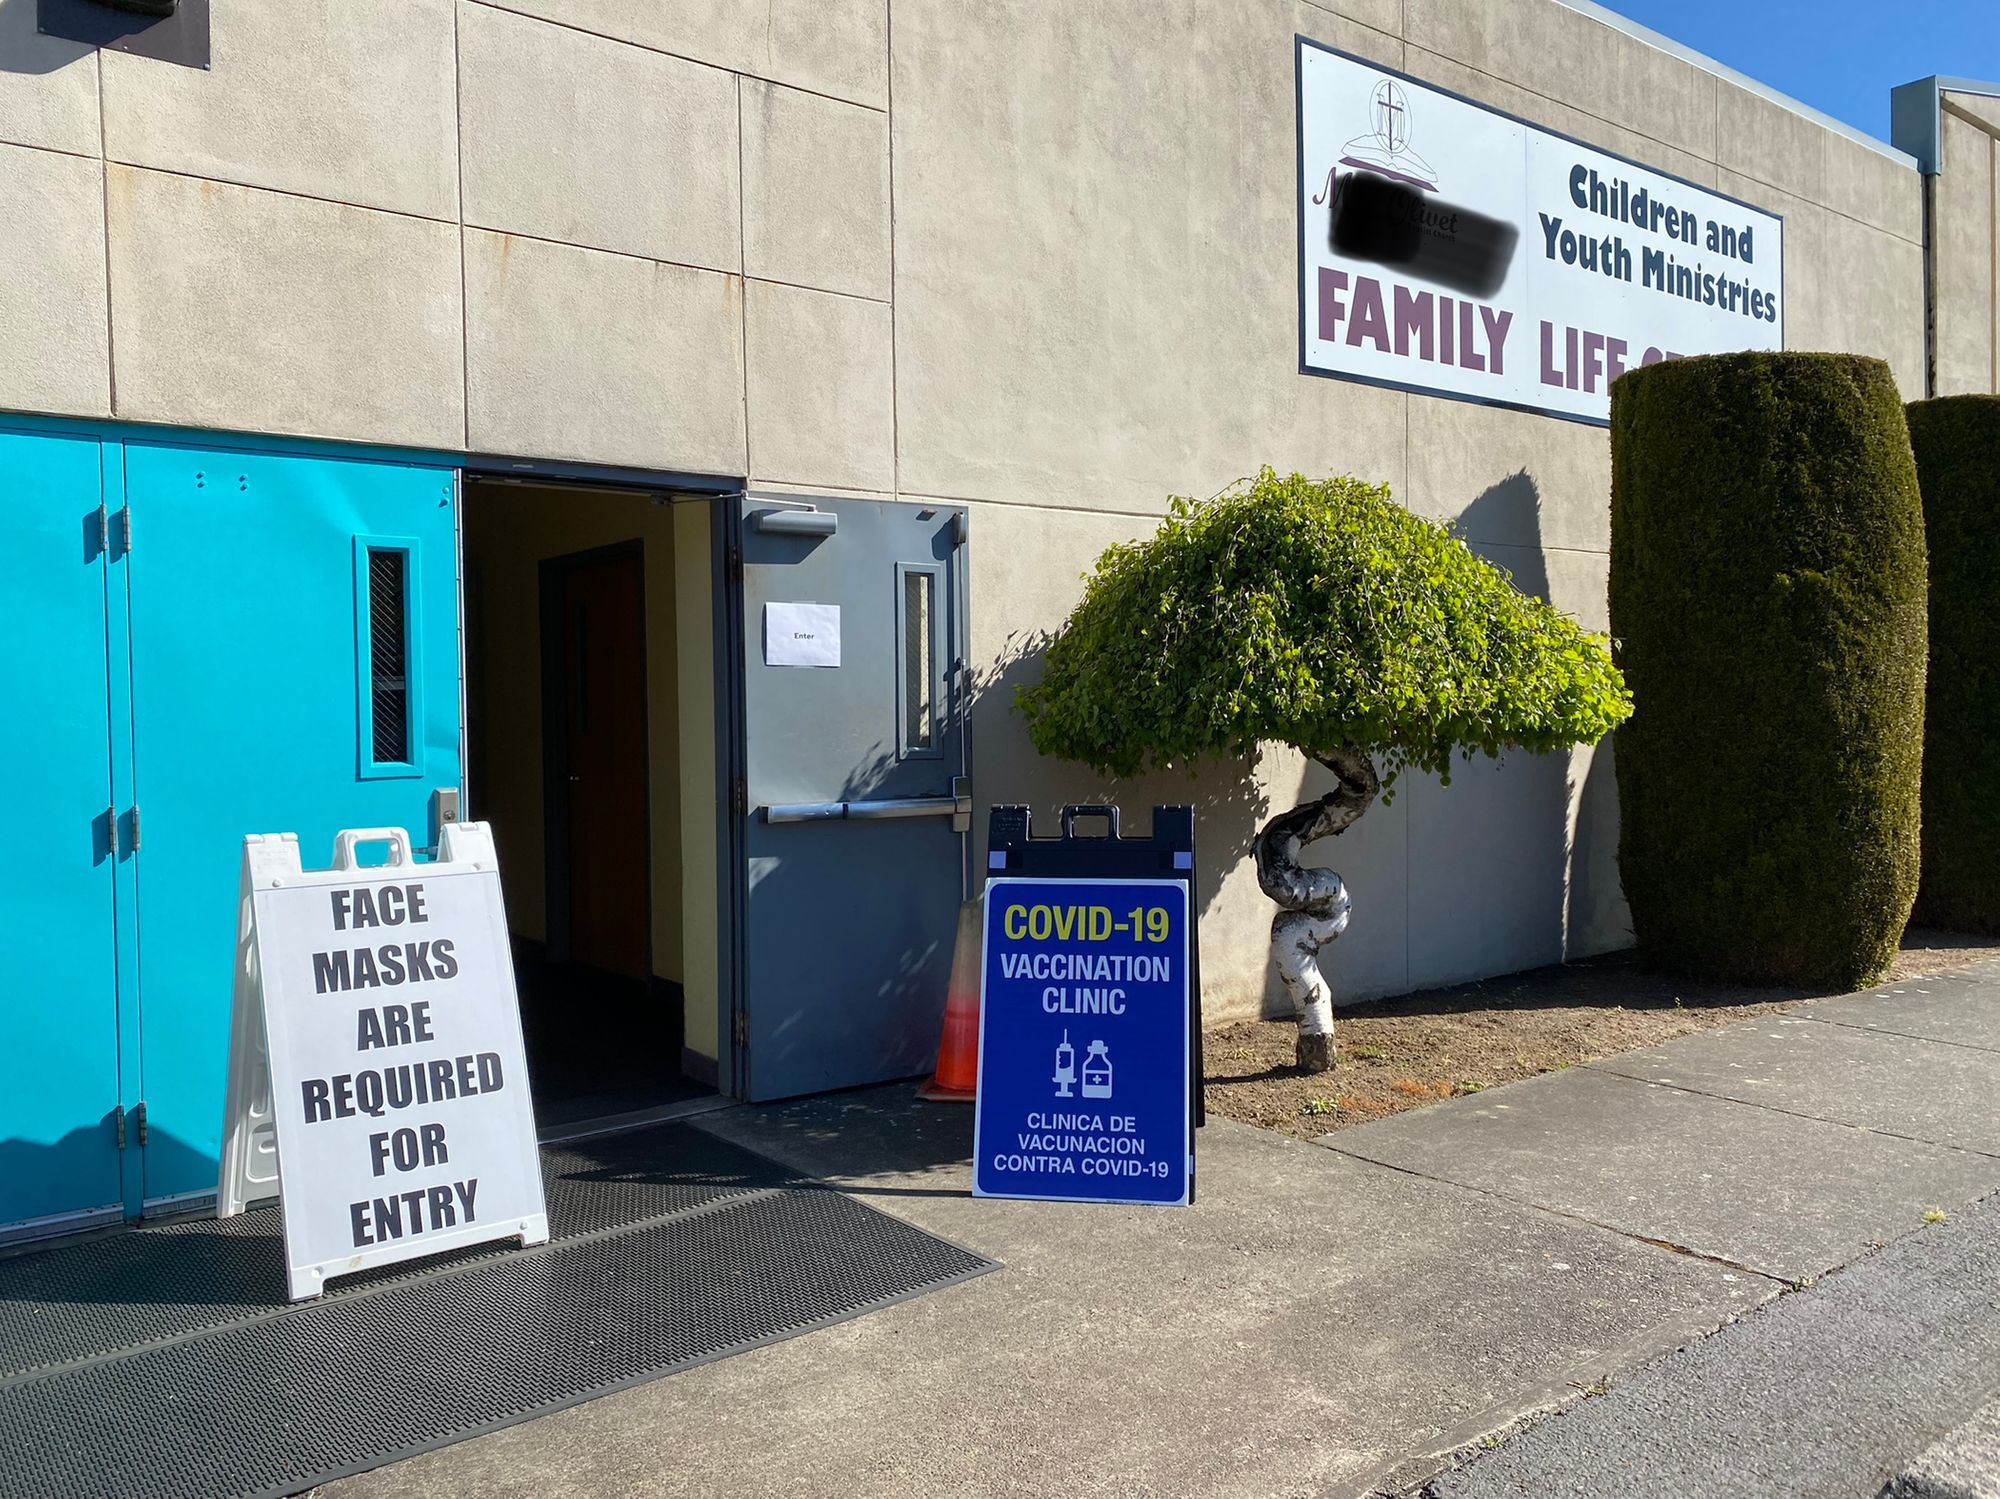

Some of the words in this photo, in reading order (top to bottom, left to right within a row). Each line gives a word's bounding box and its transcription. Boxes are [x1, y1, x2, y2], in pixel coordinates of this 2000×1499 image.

[1569, 163, 1698, 246] Children
[1706, 218, 1754, 264] and
[1538, 211, 1631, 283] Youth
[1641, 245, 1776, 324] Ministries
[1317, 265, 1514, 376] FAMILY
[793, 632, 815, 640] Enter
[330, 883, 429, 931] FACE
[1004, 904, 1169, 943] COVID-19
[312, 938, 458, 994] MASKS
[1000, 953, 1170, 982] VACCINATION
[1042, 986, 1126, 1015] CLINIC
[356, 1001, 434, 1051] ARE
[301, 1051, 504, 1124] REQUIRED
[1018, 1133, 1145, 1155] VACUNACION
[1027, 1112, 1102, 1132] CLINICA
[1110, 1115, 1136, 1133] DE
[369, 1122, 449, 1177] FOR
[993, 1154, 1076, 1175] CONTRA
[1081, 1158, 1169, 1179] COVID-19
[349, 1178, 479, 1248] ENTRY
